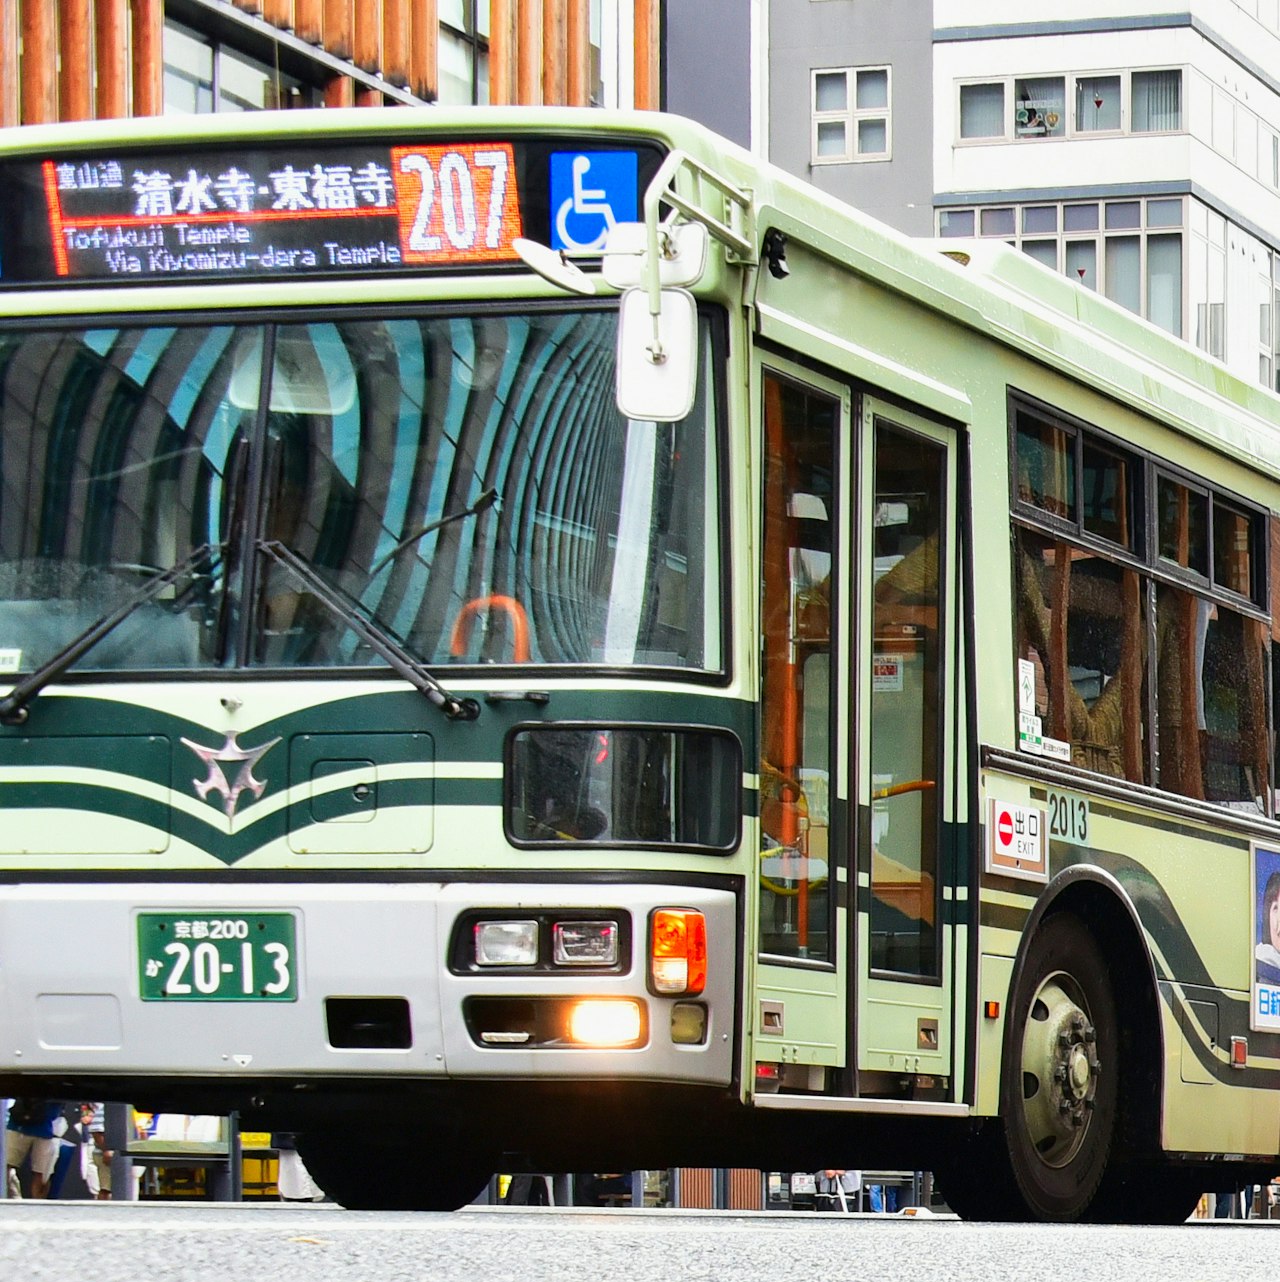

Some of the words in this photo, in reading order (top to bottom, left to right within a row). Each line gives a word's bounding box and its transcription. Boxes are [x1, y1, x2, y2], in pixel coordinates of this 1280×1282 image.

[132, 161, 396, 216] 清水寺・東福寺
[400, 150, 508, 251] 207
[63, 223, 164, 250] Tofukuji
[173, 221, 251, 246] Temple
[105, 249, 142, 273] Via
[147, 245, 317, 272] Kiyomizu-dera
[323, 241, 401, 266] Temple
[1015, 810, 1038, 837] 出口
[1049, 793, 1087, 841] 2013
[1017, 840, 1035, 857] EXIT
[165, 942, 290, 994] 20-13
